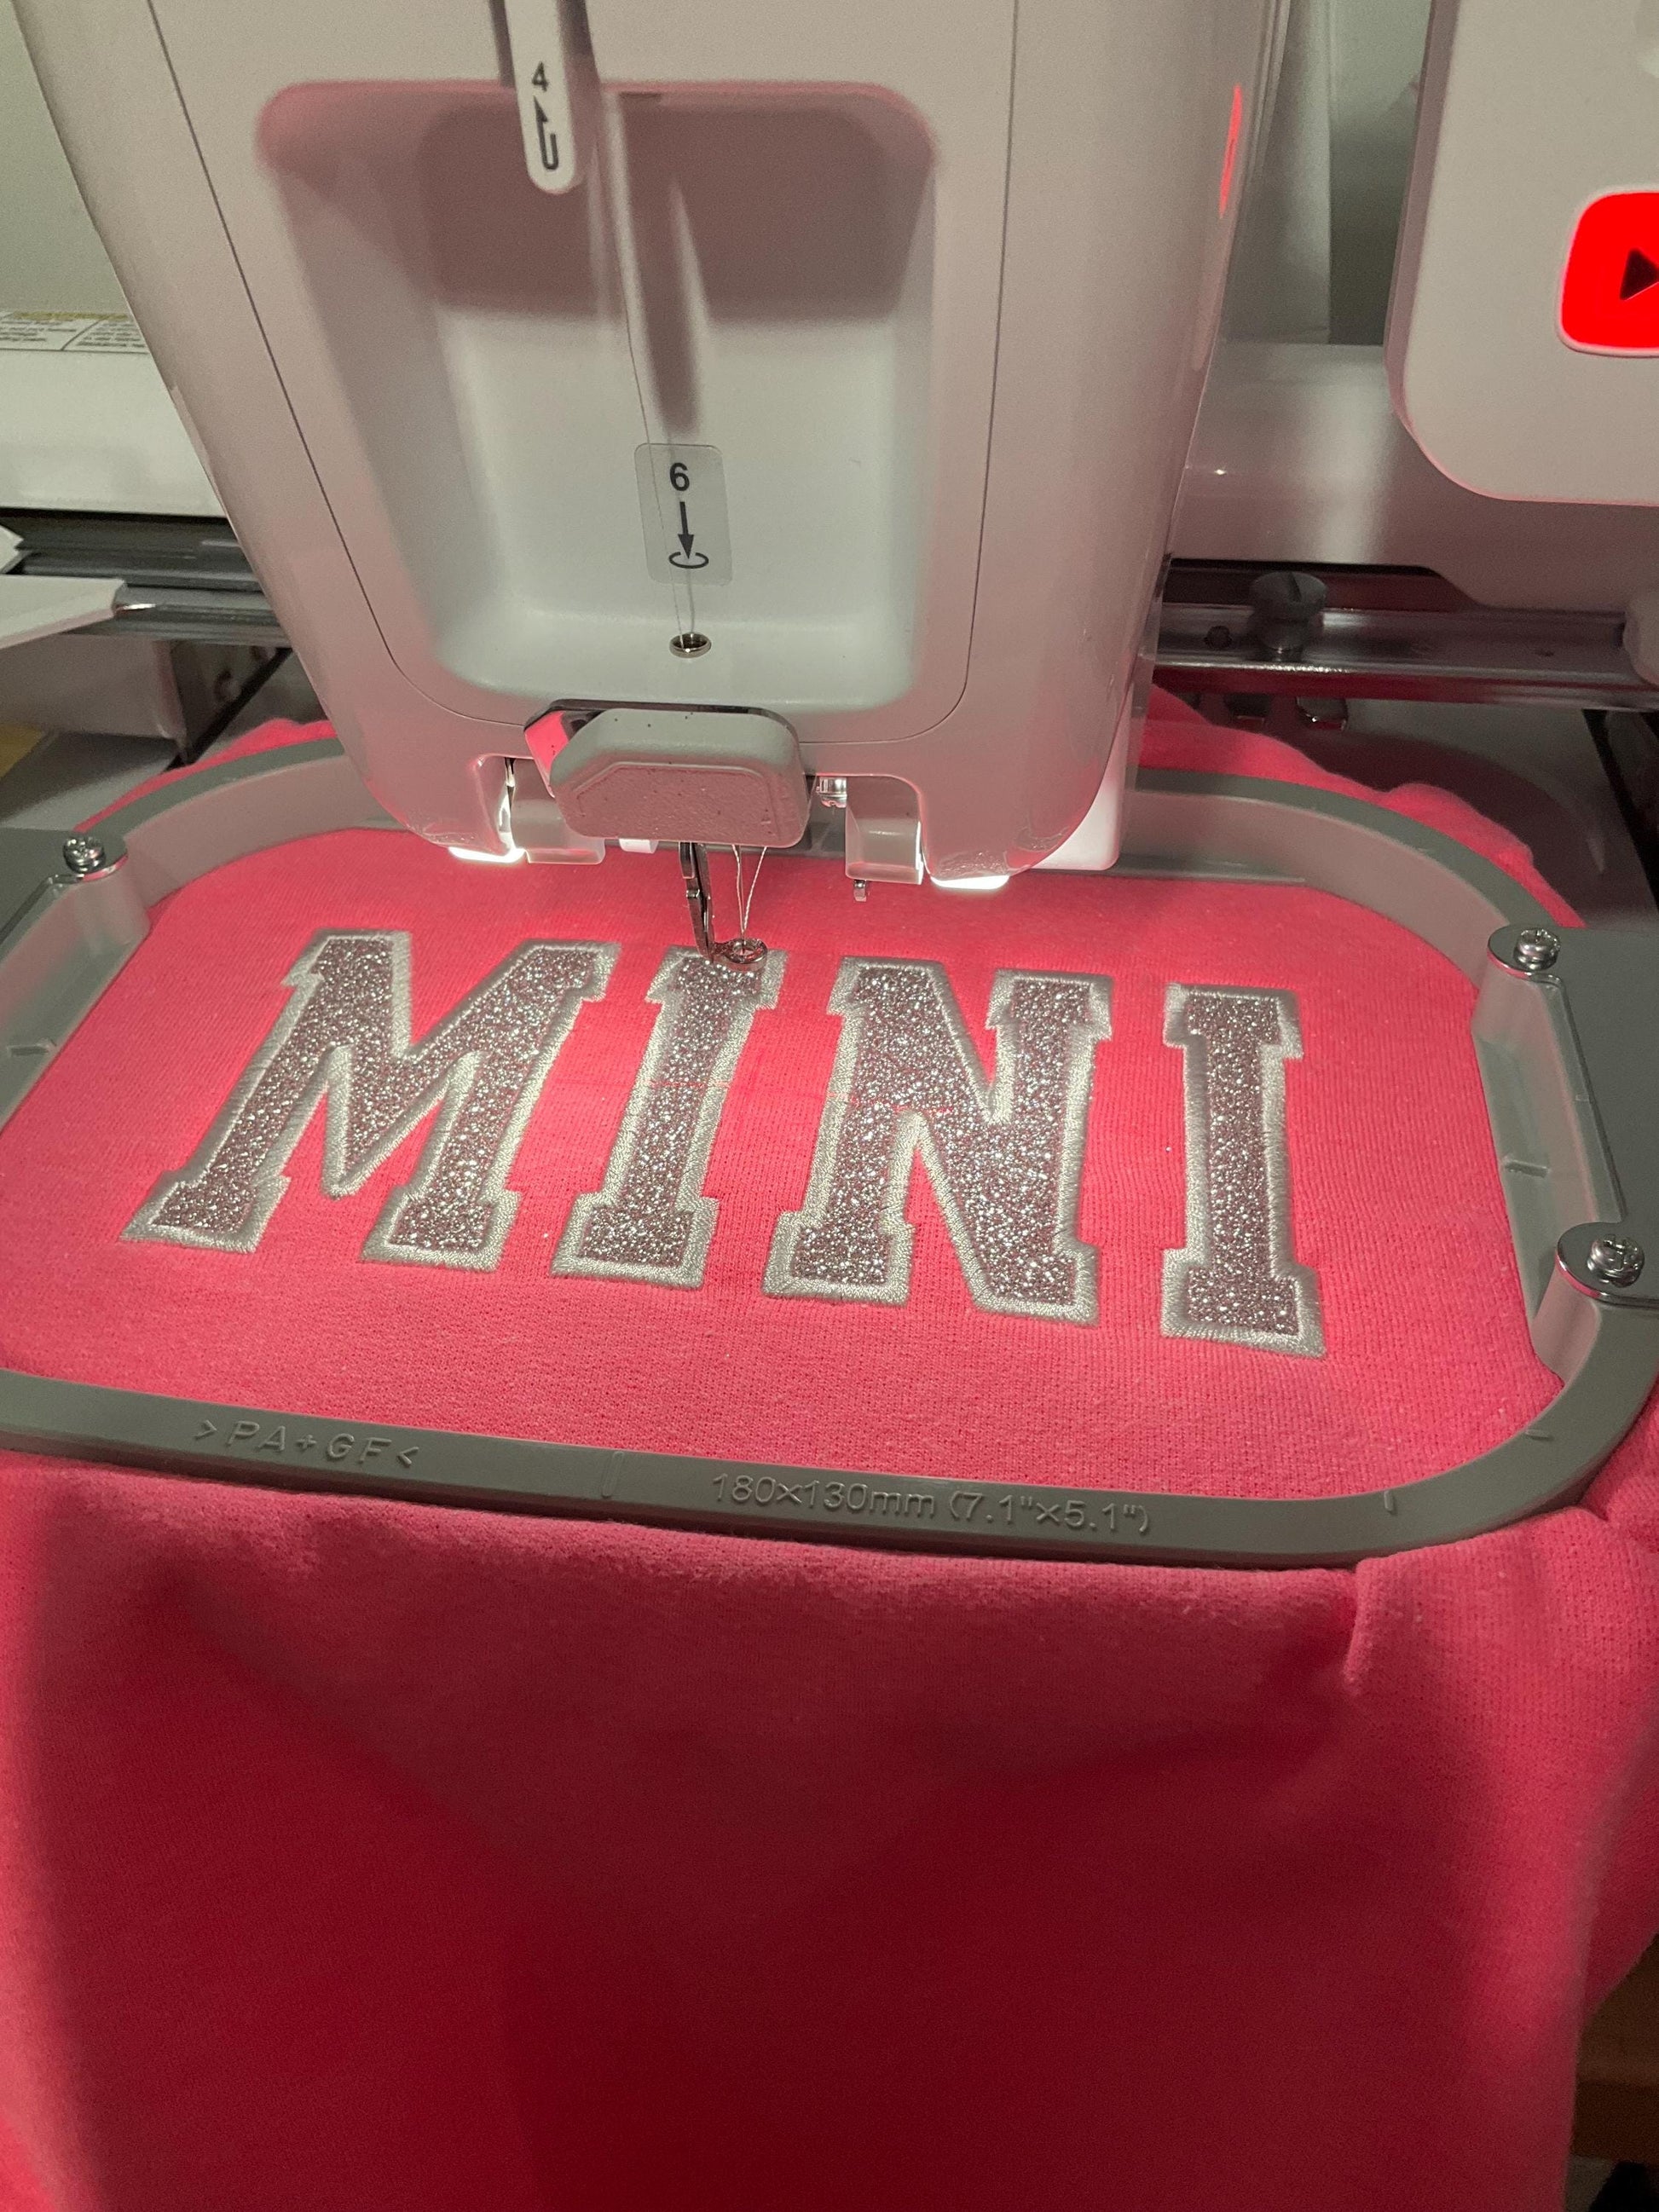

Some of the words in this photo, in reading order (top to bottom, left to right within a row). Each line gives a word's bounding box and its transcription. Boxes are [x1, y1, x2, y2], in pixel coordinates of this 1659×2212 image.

[532, 61, 549, 92] 4
[669, 462, 690, 491] 6
[119, 929, 1326, 1357] MINI
